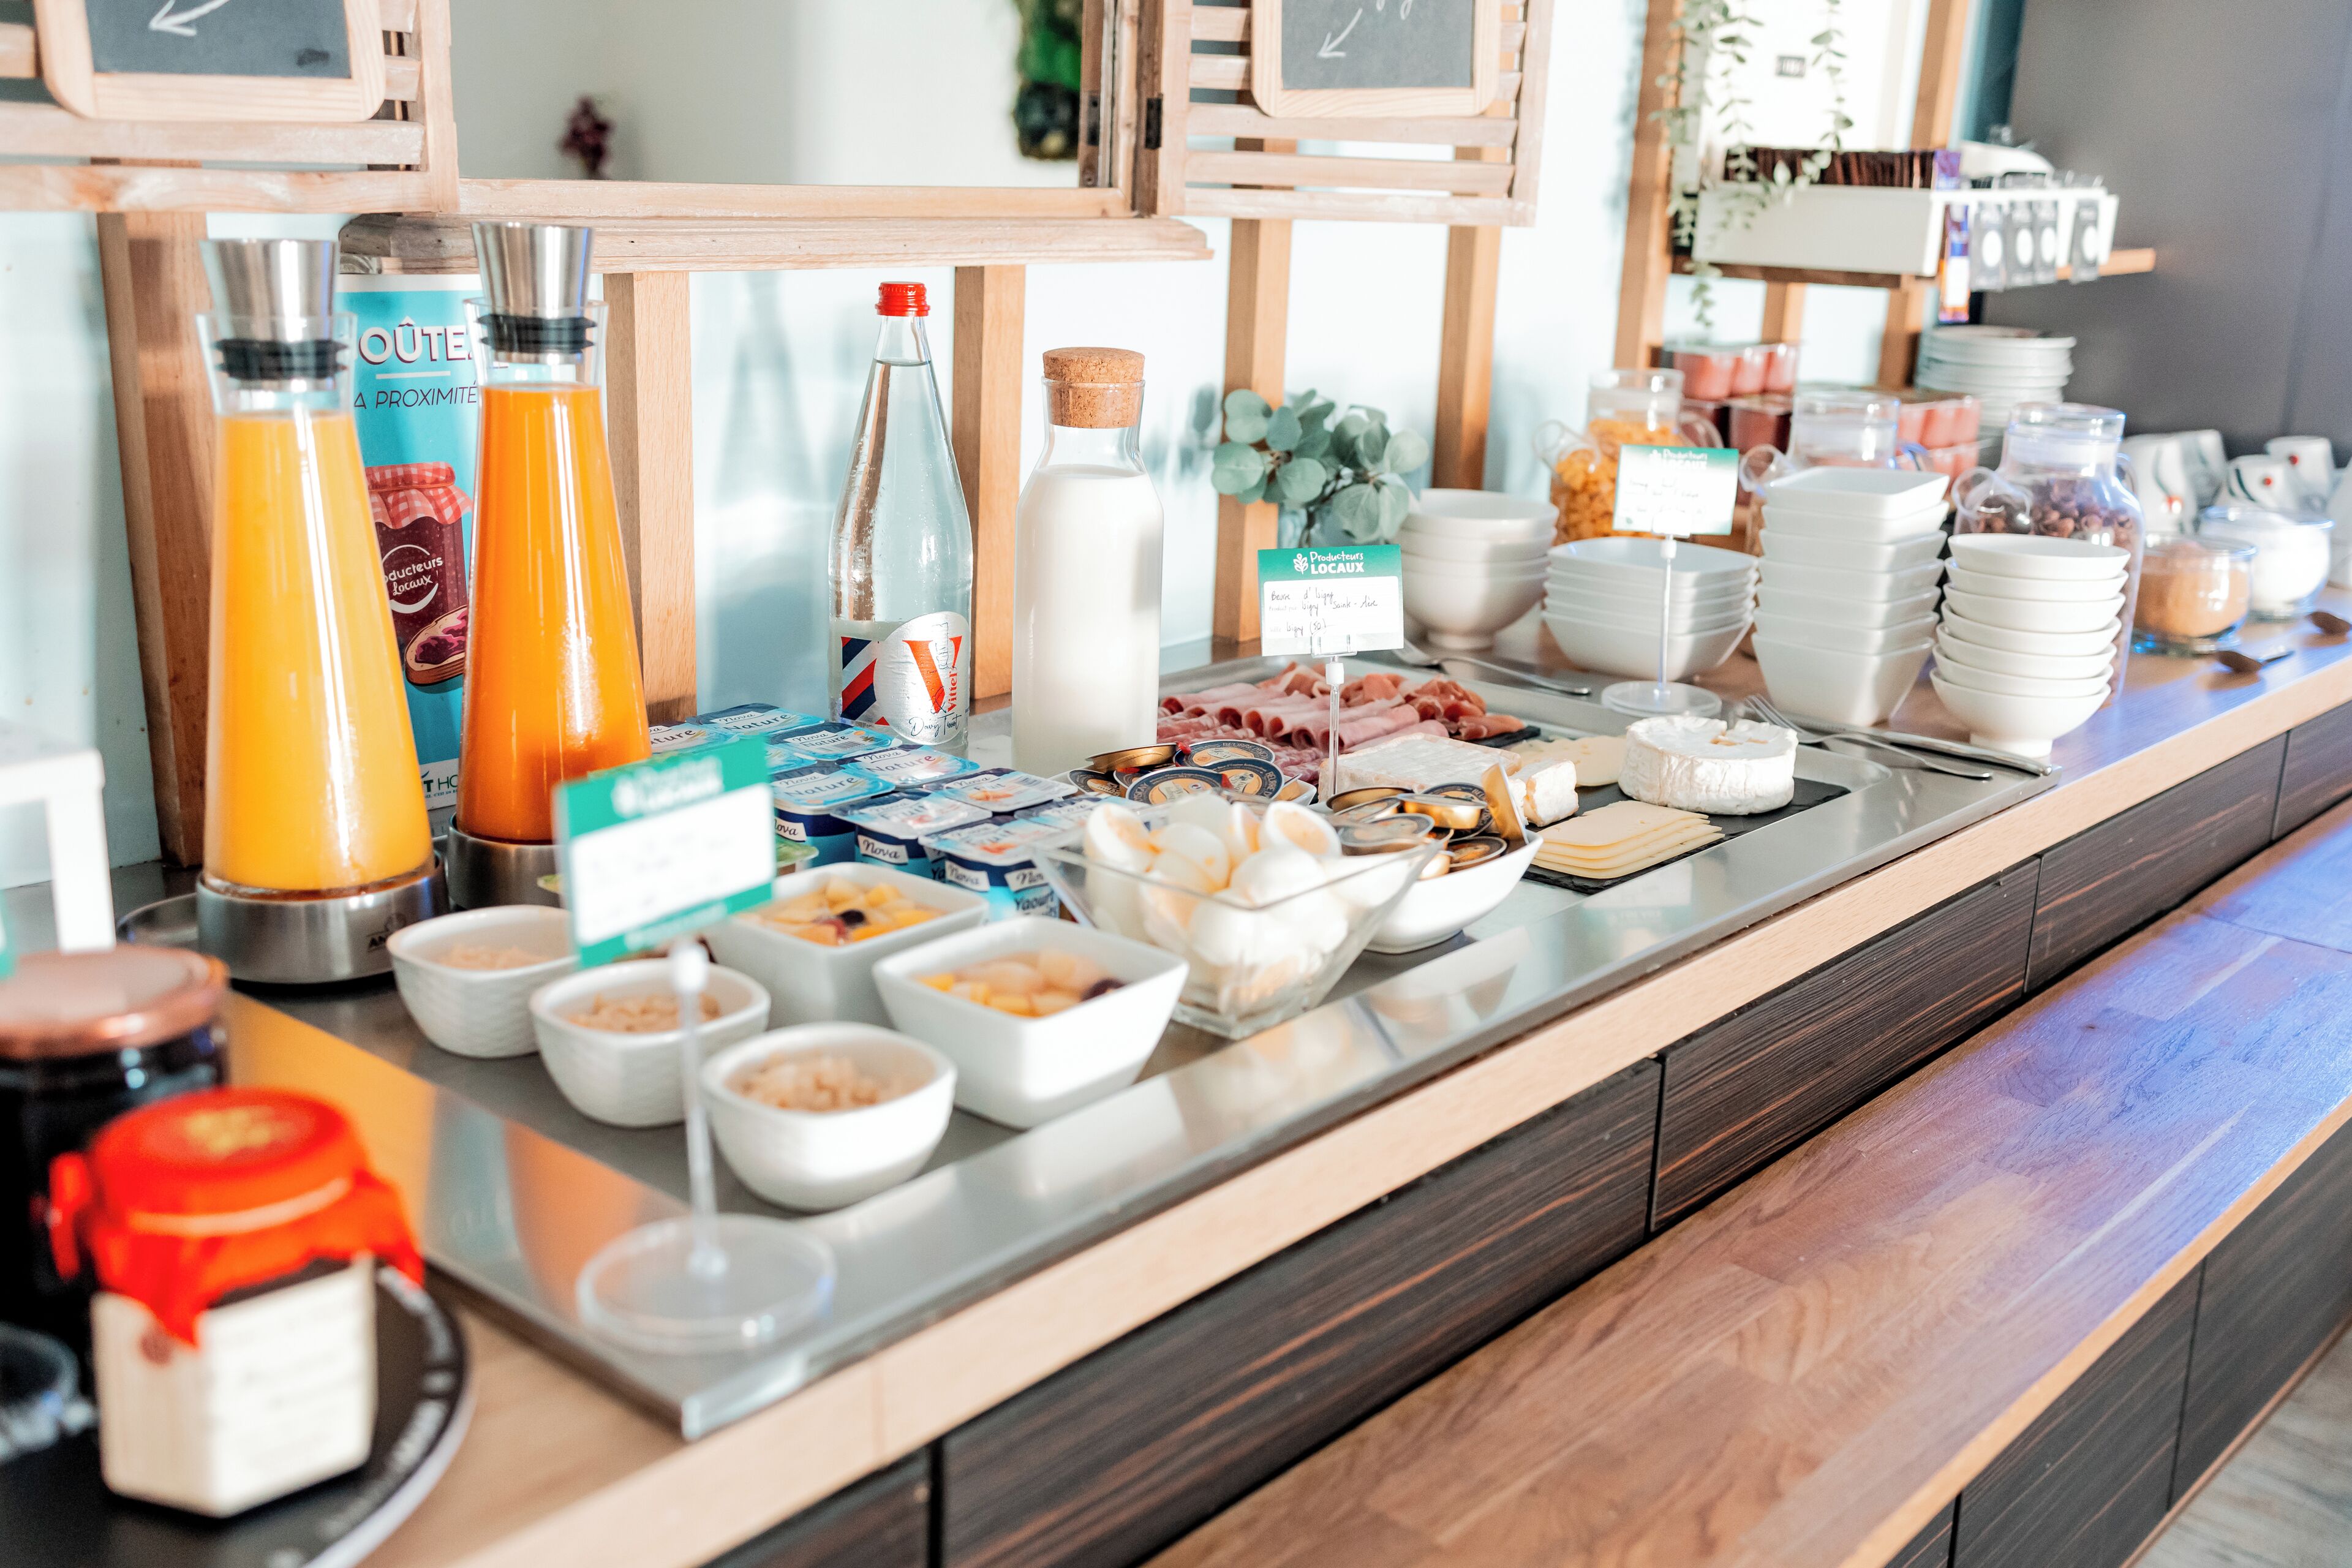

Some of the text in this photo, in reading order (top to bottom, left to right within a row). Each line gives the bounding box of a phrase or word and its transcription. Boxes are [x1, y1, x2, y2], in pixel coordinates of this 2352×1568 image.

[355, 315, 472, 366] OÛTE
[354, 380, 478, 409] A PROXIMITÉ
[1310, 551, 1363, 563] Producteurs
[1311, 562, 1365, 575] LOCAUX
[723, 713, 791, 731] Nature
[651, 729, 696, 745] ature
[792, 733, 829, 742] Nova
[803, 734, 849, 748] Nature
[864, 750, 902, 761] Nova
[865, 755, 937, 773] Nature
[784, 777, 859, 797] Nature
[863, 839, 900, 858] Nova
